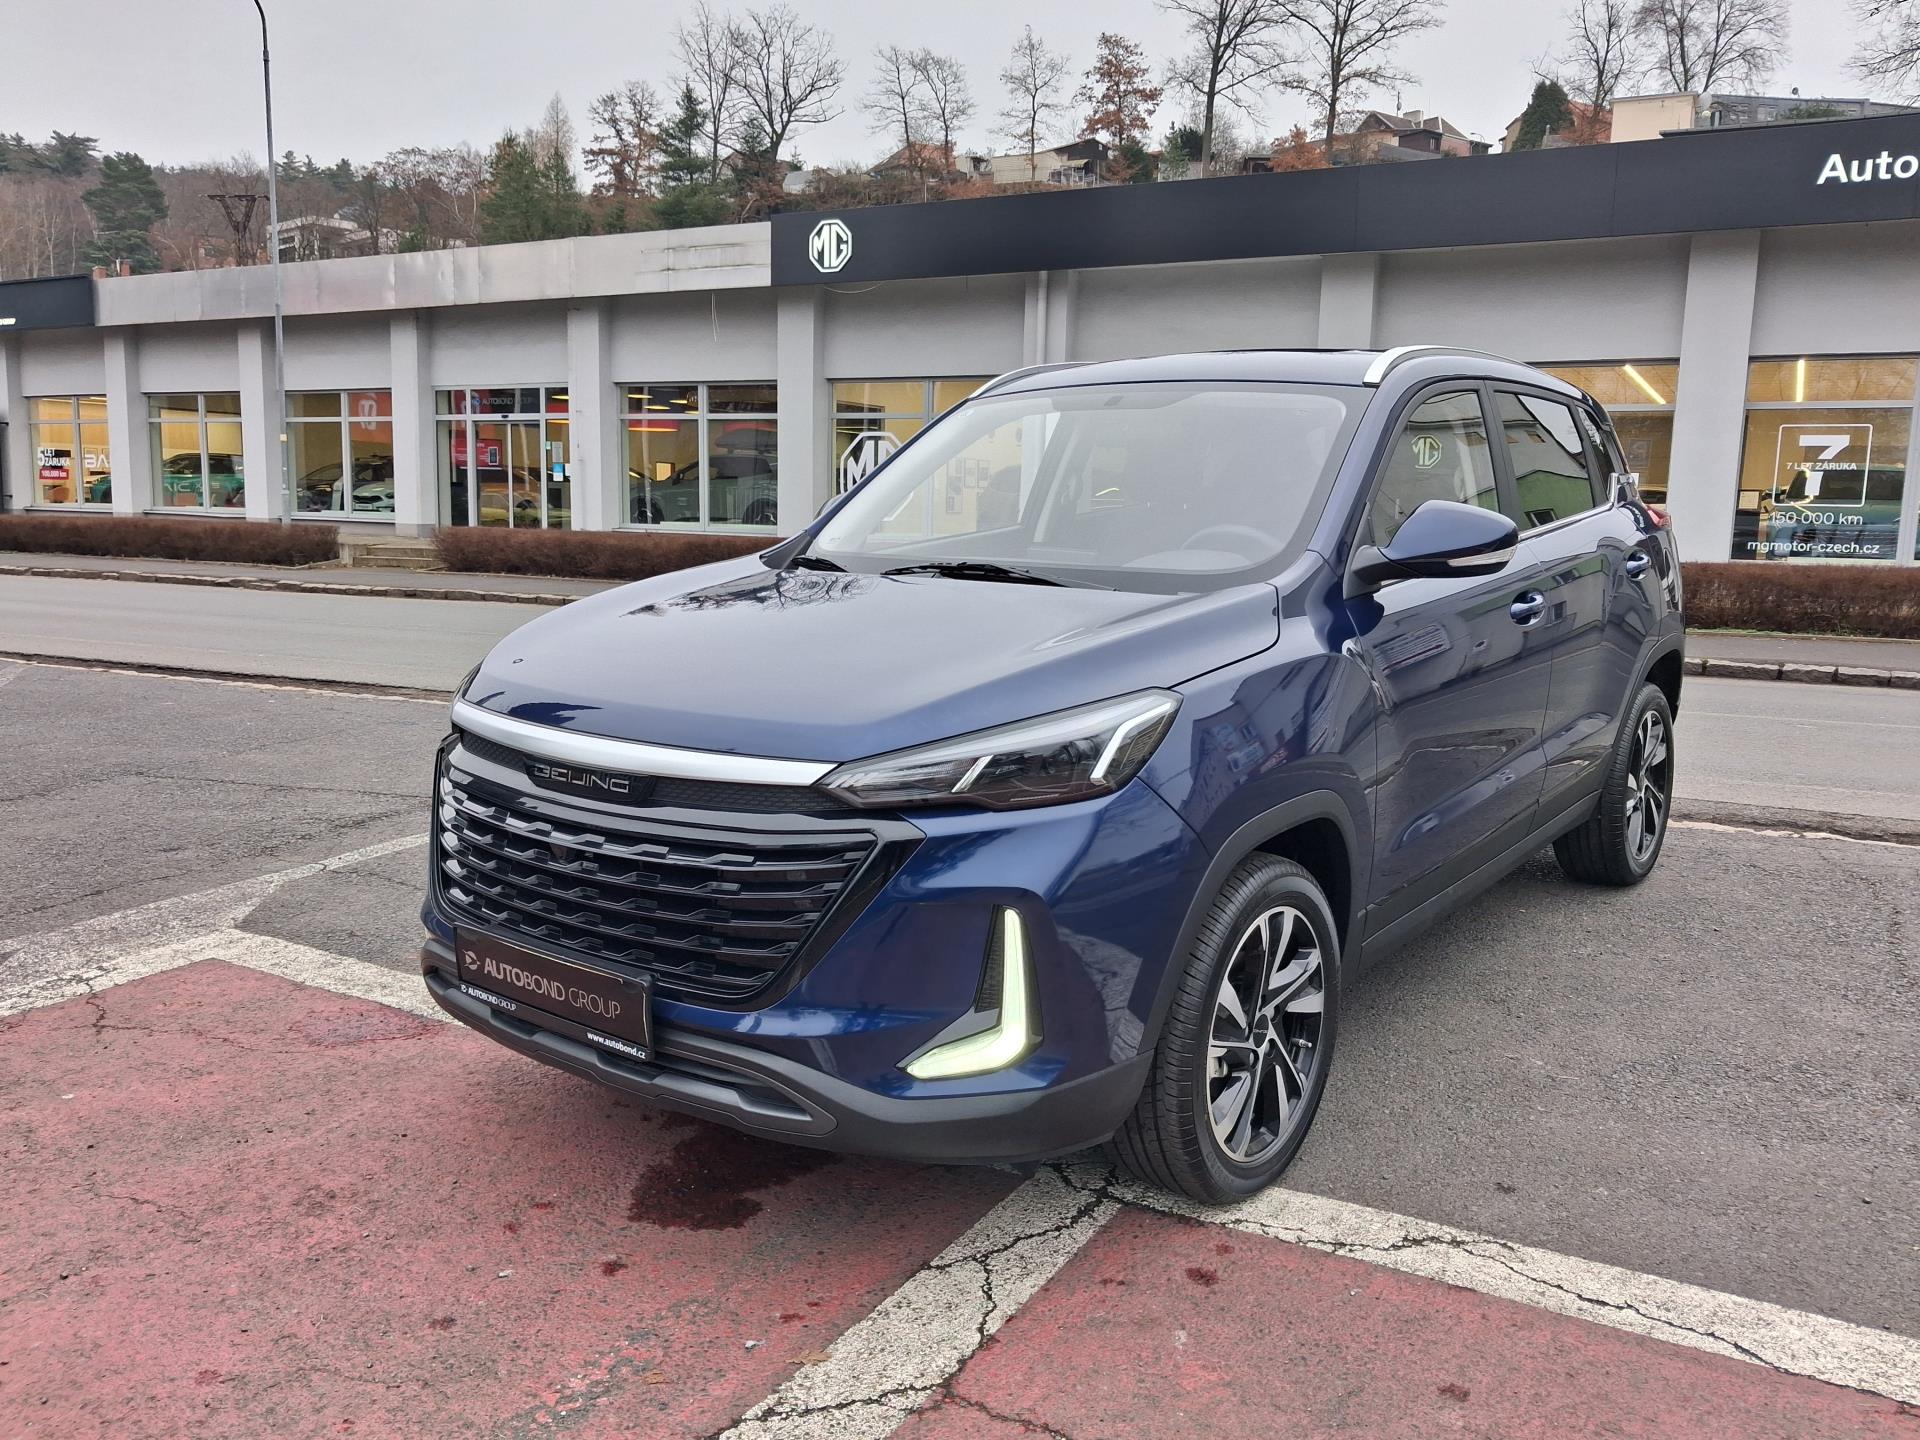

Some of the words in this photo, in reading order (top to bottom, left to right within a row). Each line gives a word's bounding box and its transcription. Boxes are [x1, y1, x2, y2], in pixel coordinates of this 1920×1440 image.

[1816, 151, 1920, 185] Auto
[811, 222, 850, 270] MG
[38, 447, 45, 466] 5
[1786, 462, 1793, 470] 7
[1794, 462, 1814, 470] LET
[1815, 460, 1857, 470] ZÁRUKA
[1769, 511, 1797, 524] 150
[1801, 512, 1834, 525] 000
[1839, 513, 1863, 525] km
[1747, 540, 1880, 554] mgmotor-czech.cz
[534, 763, 629, 793] BEIJING
[468, 987, 498, 1004] AUTOBOND
[484, 957, 566, 1001] AUTOBOND
[568, 987, 621, 1019] GROUP
[586, 1031, 646, 1059] www.autobond.cz
